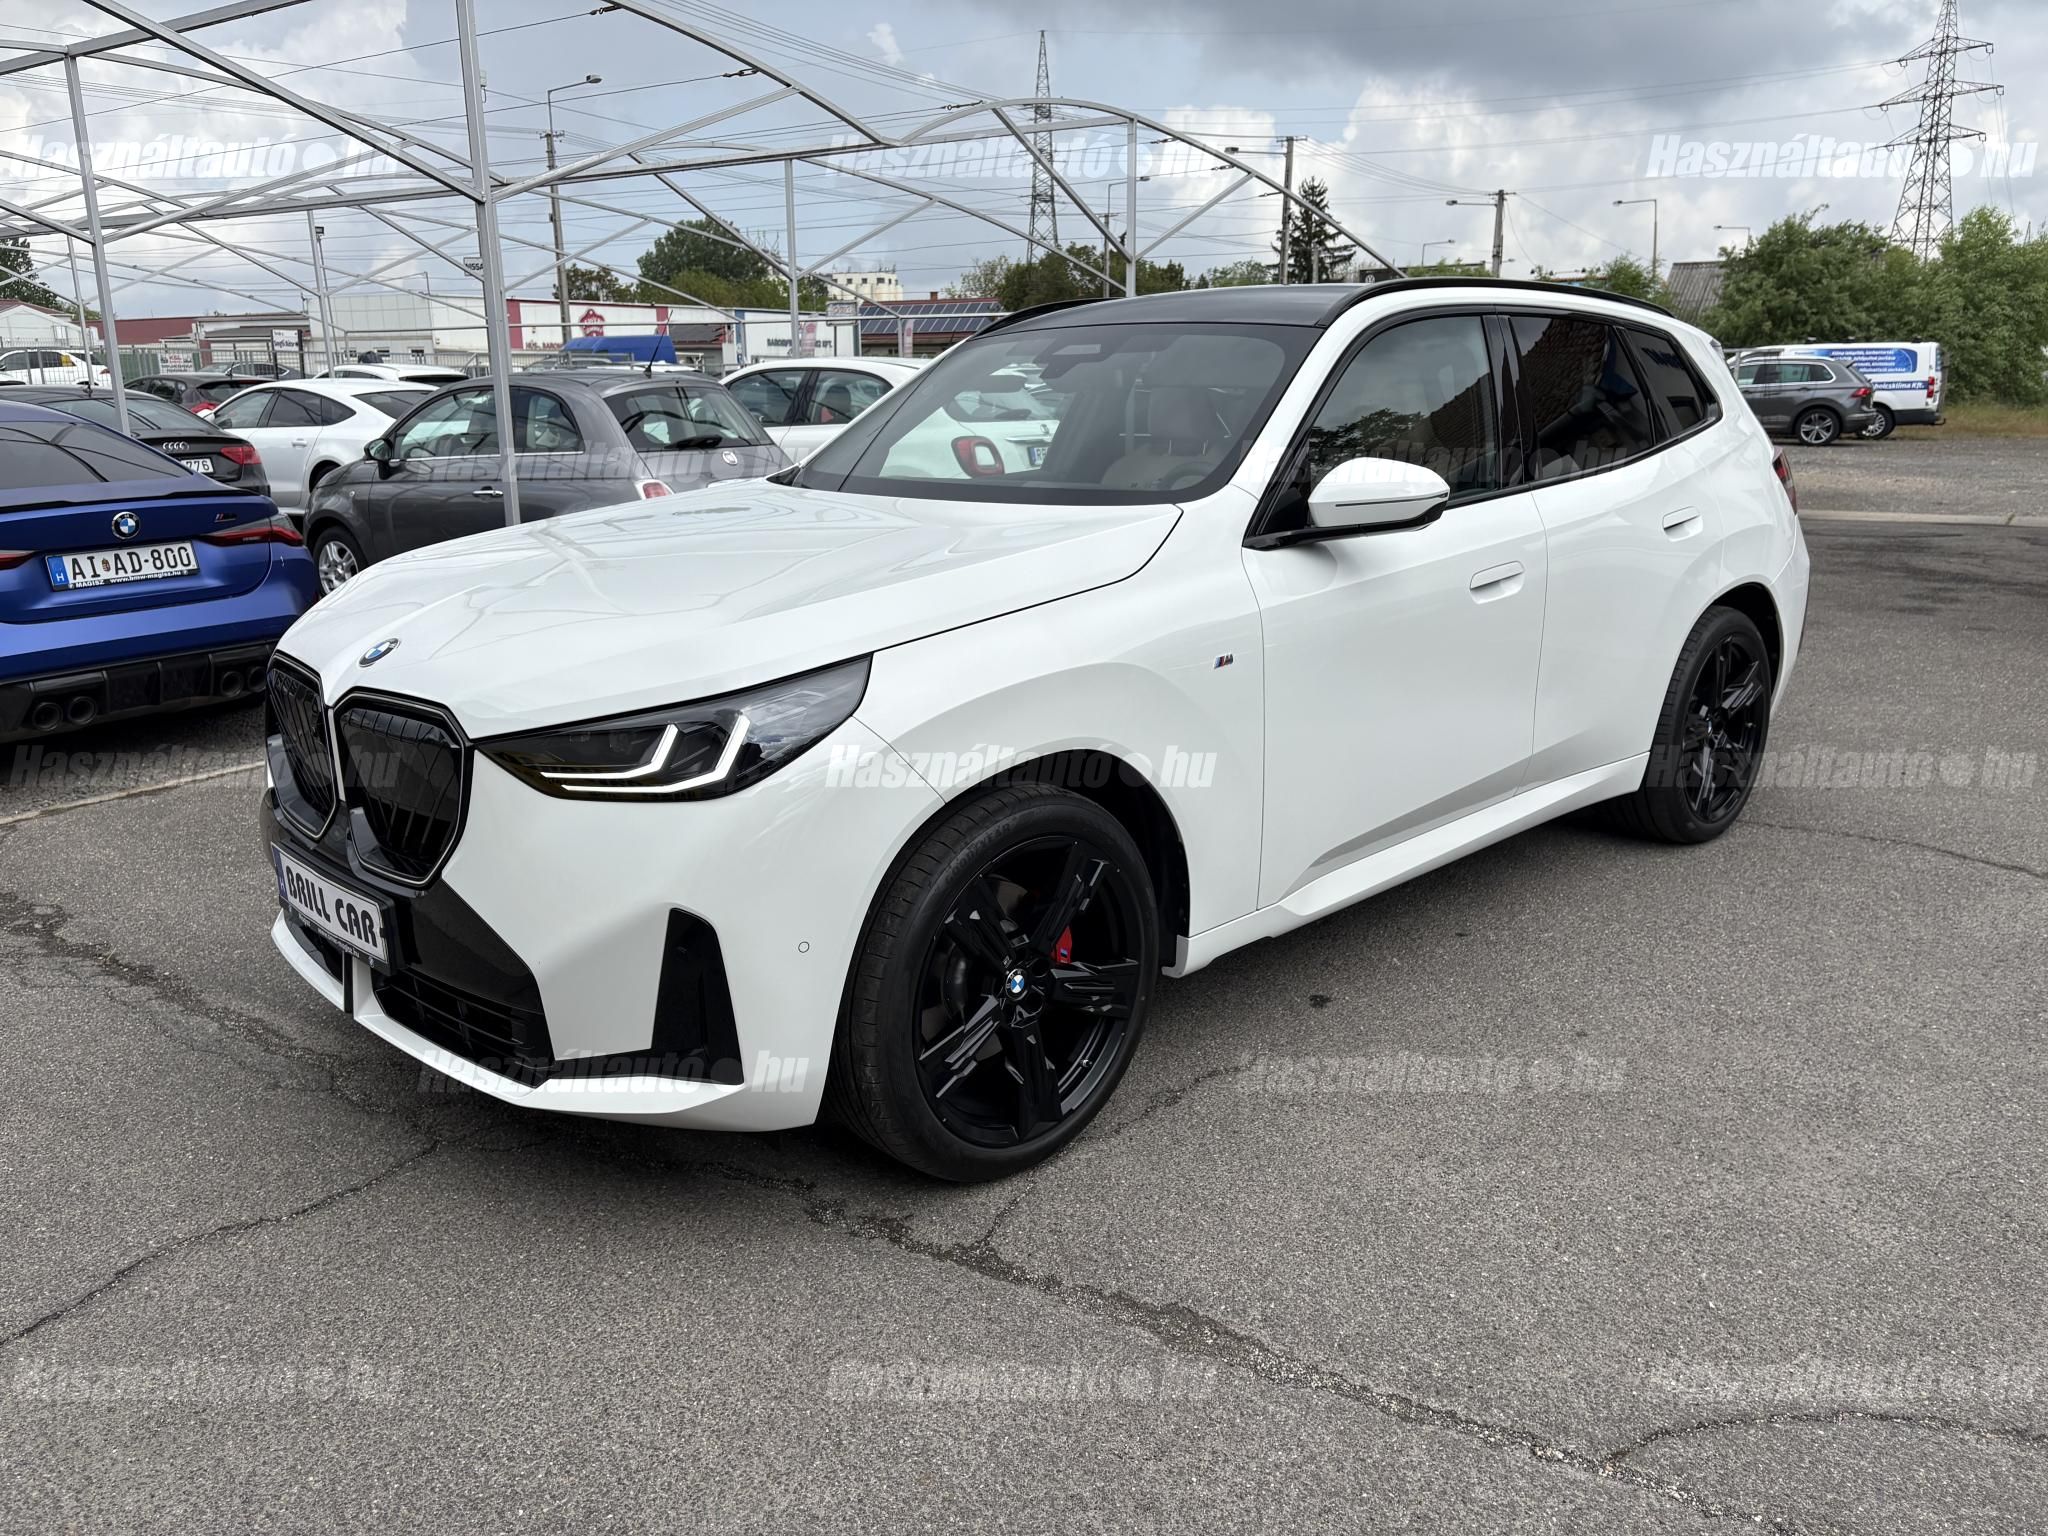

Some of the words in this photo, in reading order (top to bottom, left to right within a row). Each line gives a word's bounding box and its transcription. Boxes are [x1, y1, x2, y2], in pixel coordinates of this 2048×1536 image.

[71, 556, 101, 581] AI
[113, 546, 192, 576] AD-800
[56, 573, 65, 582] H
[75, 578, 105, 588] MAGISZ
[286, 865, 331, 923] BRILL
[335, 898, 378, 948] CAR
